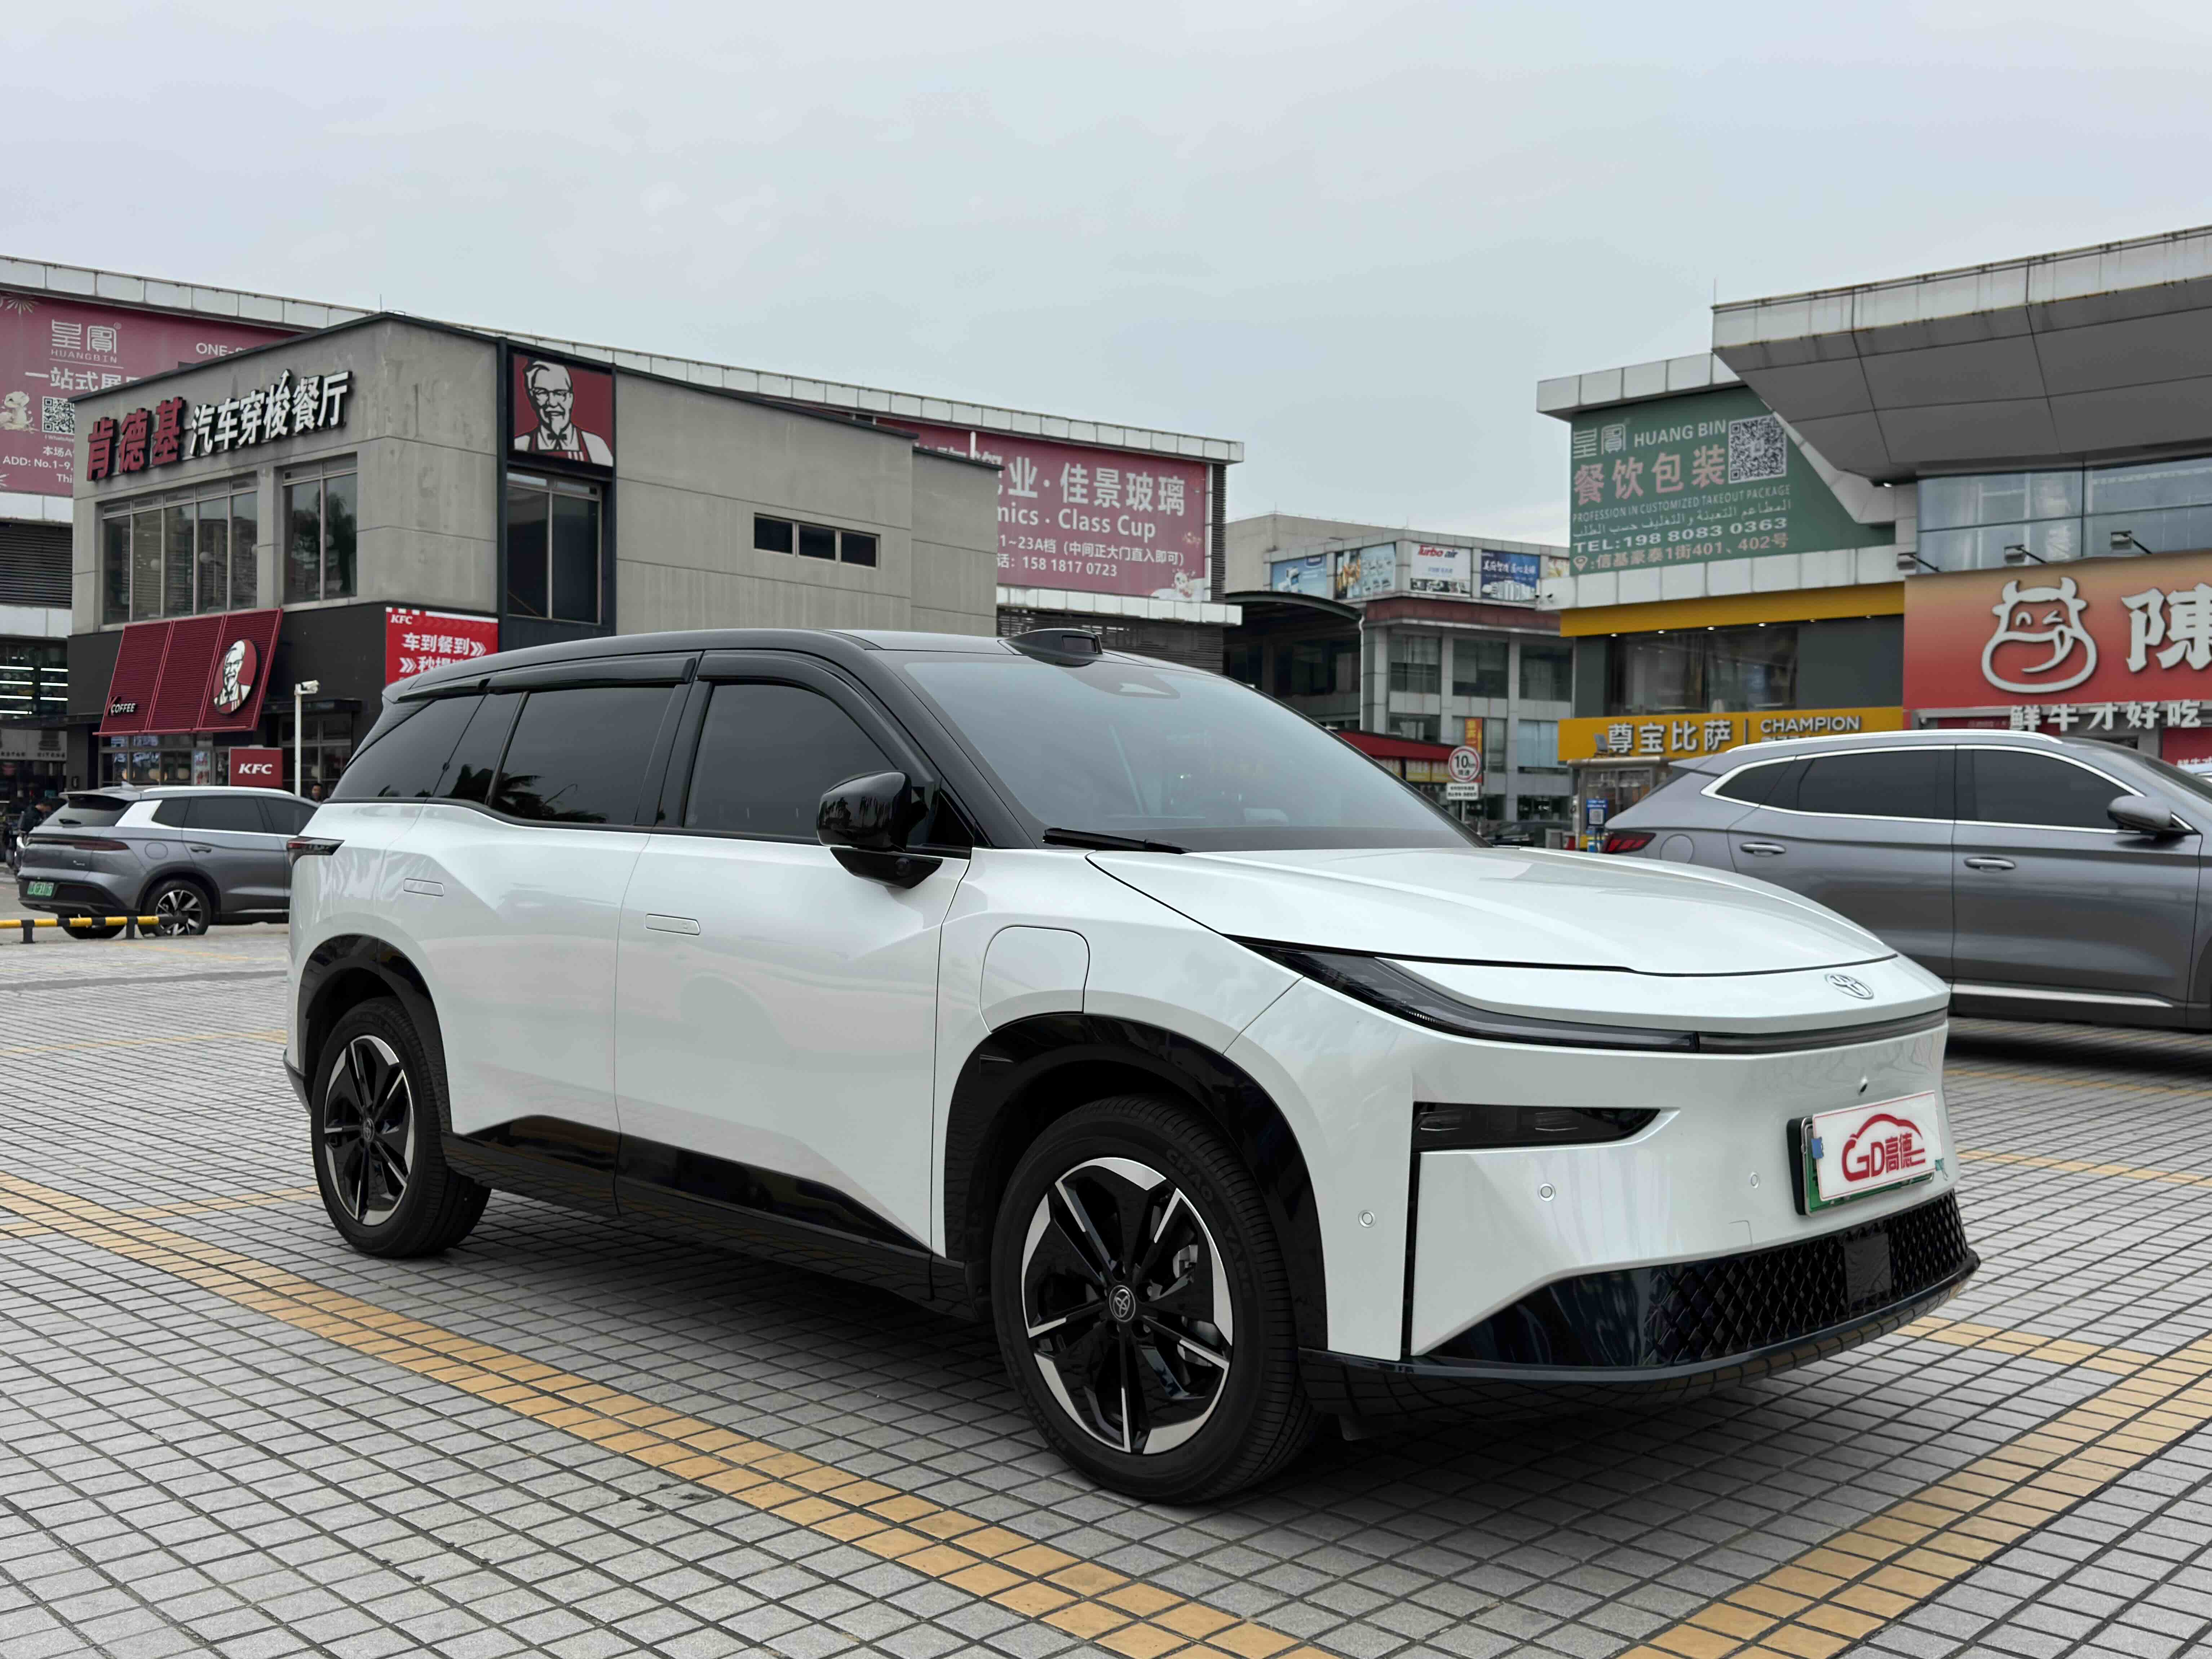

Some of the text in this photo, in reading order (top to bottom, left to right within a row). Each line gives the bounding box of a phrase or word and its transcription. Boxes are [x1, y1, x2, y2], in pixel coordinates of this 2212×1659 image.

[51, 348, 118, 363] HUANGBIN
[25, 366, 141, 392] 一站式展
[87, 369, 350, 481] 肯德基 汽车穿梭餐厅
[1634, 425, 1693, 447] HUANG
[1698, 419, 1726, 438] BIN
[3, 455, 31, 466] ADD:
[981, 452, 1185, 517] 业·佳景玻璃
[1573, 444, 1725, 506] 餐饮包装
[1572, 484, 1791, 523] PROFESSION IN CUSTOMIZED TAKEOUT PACKAGE
[1058, 508, 1111, 534] Class
[1117, 515, 1156, 543] Cup
[1667, 525, 1723, 542] 8083
[1730, 517, 1788, 535] 0363
[1418, 544, 1443, 557] Turbo
[1023, 556, 1047, 570] 158
[1051, 559, 1083, 574] 1817
[1086, 562, 1117, 577] 0723
[390, 614, 413, 625] KFC
[401, 632, 470, 655] 车到餐到
[111, 703, 136, 713] COFFEE
[2009, 700, 2202, 732] 鲜牛才好吃
[1607, 715, 1861, 753] 尊宝比萨 CHAMPION
[238, 763, 273, 775] KFC
